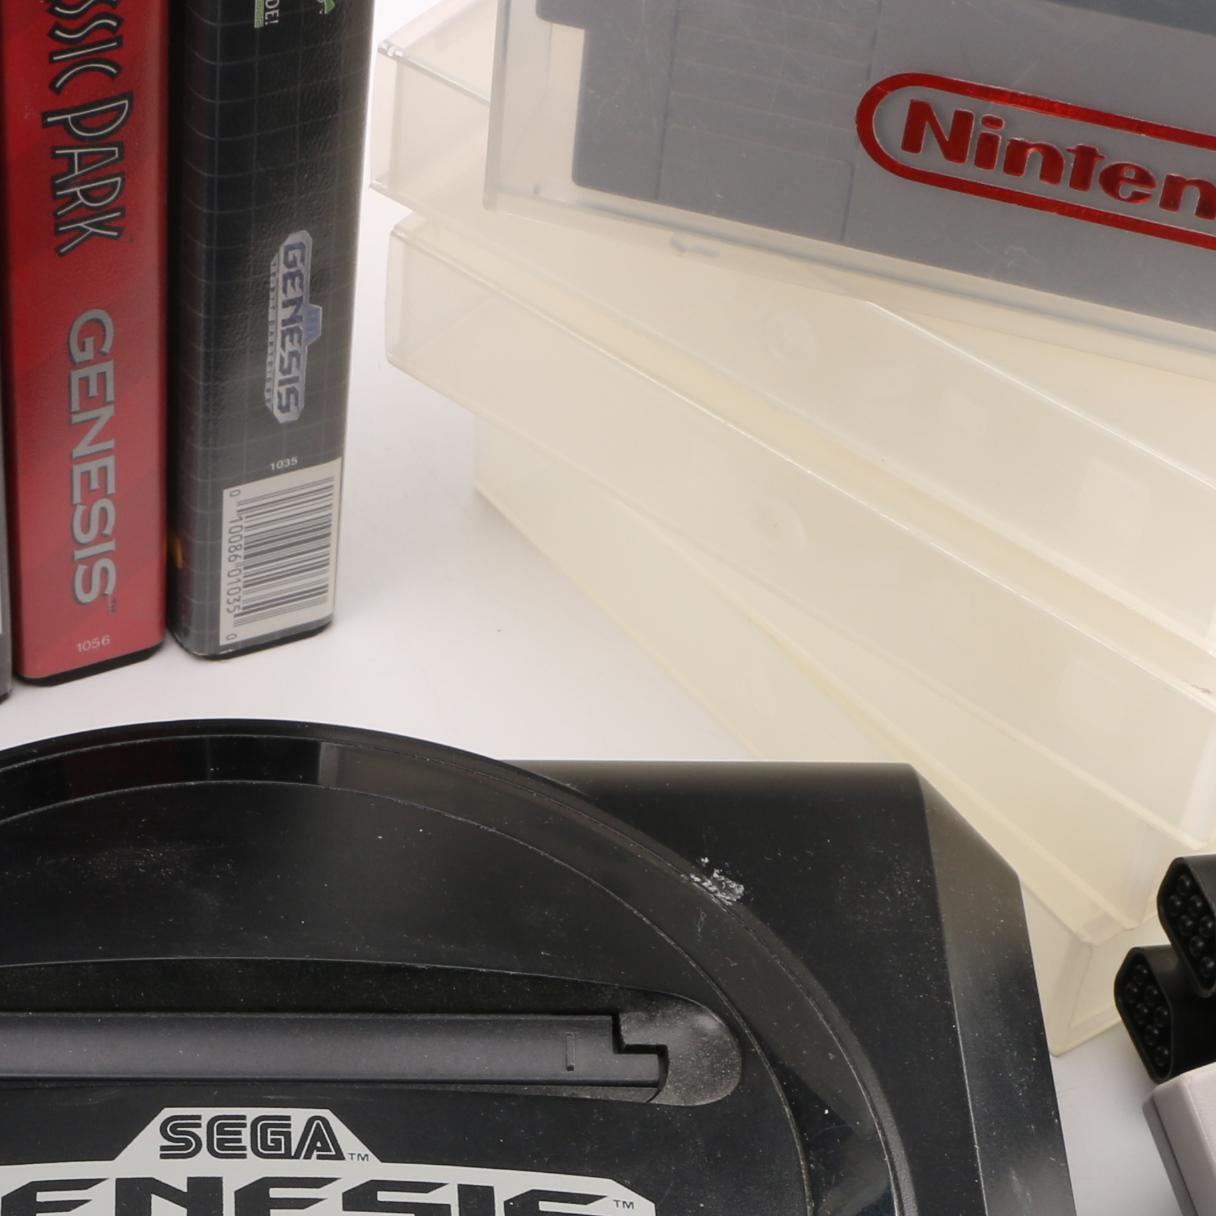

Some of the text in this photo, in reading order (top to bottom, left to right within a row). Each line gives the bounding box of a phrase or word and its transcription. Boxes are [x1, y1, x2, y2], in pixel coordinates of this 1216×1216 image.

[42, 91, 134, 259] PARK
[901, 98, 1216, 221] Ninten
[277, 241, 306, 414] GENESIS
[68, 308, 117, 606] GENESIS
[270, 456, 299, 471] 1035
[76, 634, 112, 654] 1056
[158, 1113, 347, 1162] SEGA
